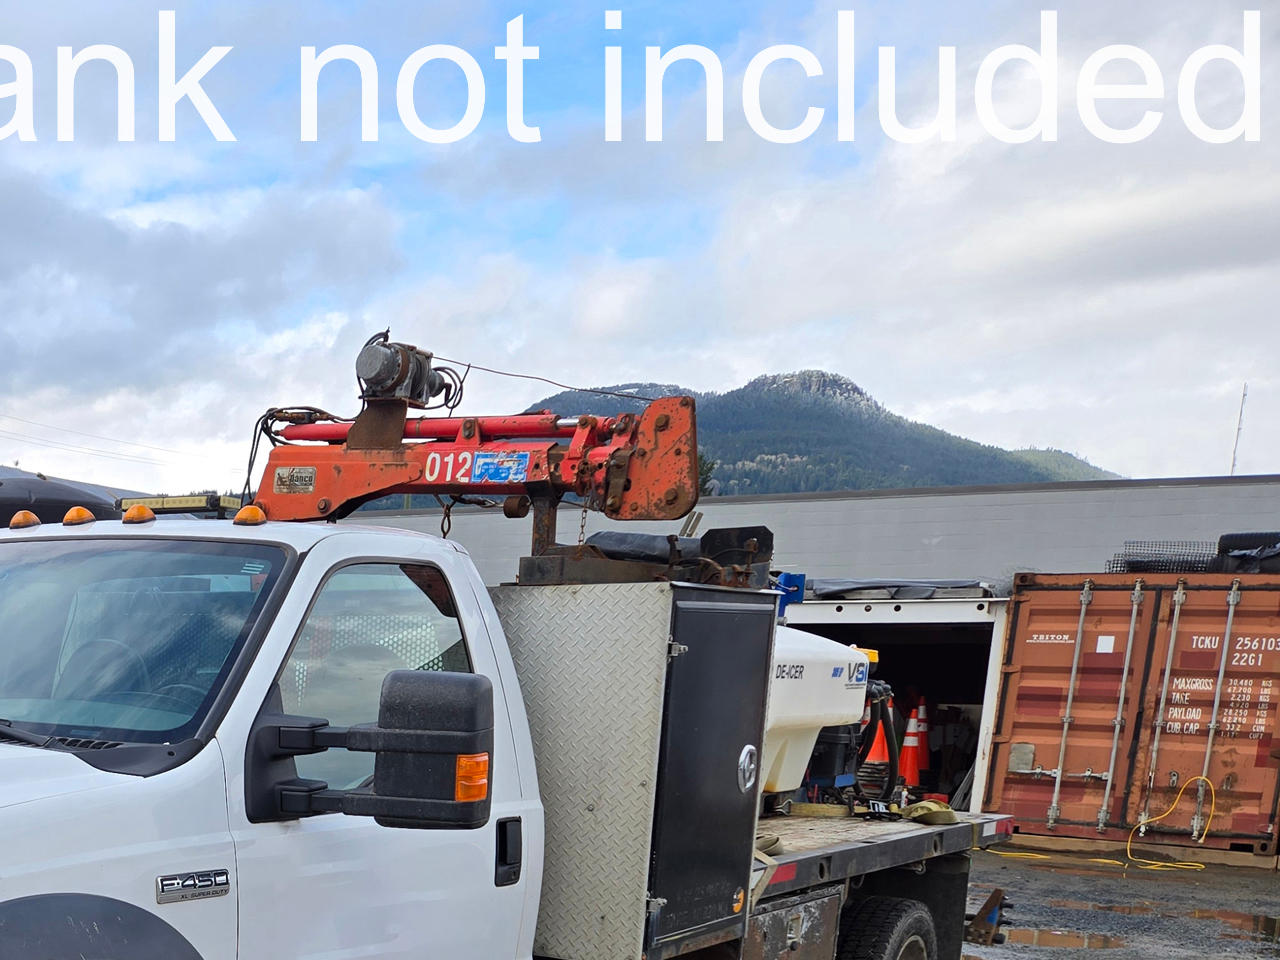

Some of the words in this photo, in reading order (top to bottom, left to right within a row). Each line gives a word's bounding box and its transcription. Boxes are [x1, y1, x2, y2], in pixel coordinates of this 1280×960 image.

[425, 451, 472, 483] 012
[1192, 636, 1220, 648] TCKU
[1235, 637, 1280, 650] 256103
[1232, 653, 1263, 666] 22G1
[775, 664, 804, 679] DE-ICER
[1227, 686, 1252, 694] 67.200
[1171, 692, 1191, 704] TARE
[1230, 693, 1251, 701] 2.230
[1258, 694, 1270, 702] KGS
[1168, 707, 1202, 720] PAYLOAD
[1255, 717, 1266, 725] LBS
[1183, 723, 1200, 735] CAP.
[160, 871, 229, 894] F-450
[191, 891, 211, 899] SUPER
[212, 888, 229, 896] DUTY
